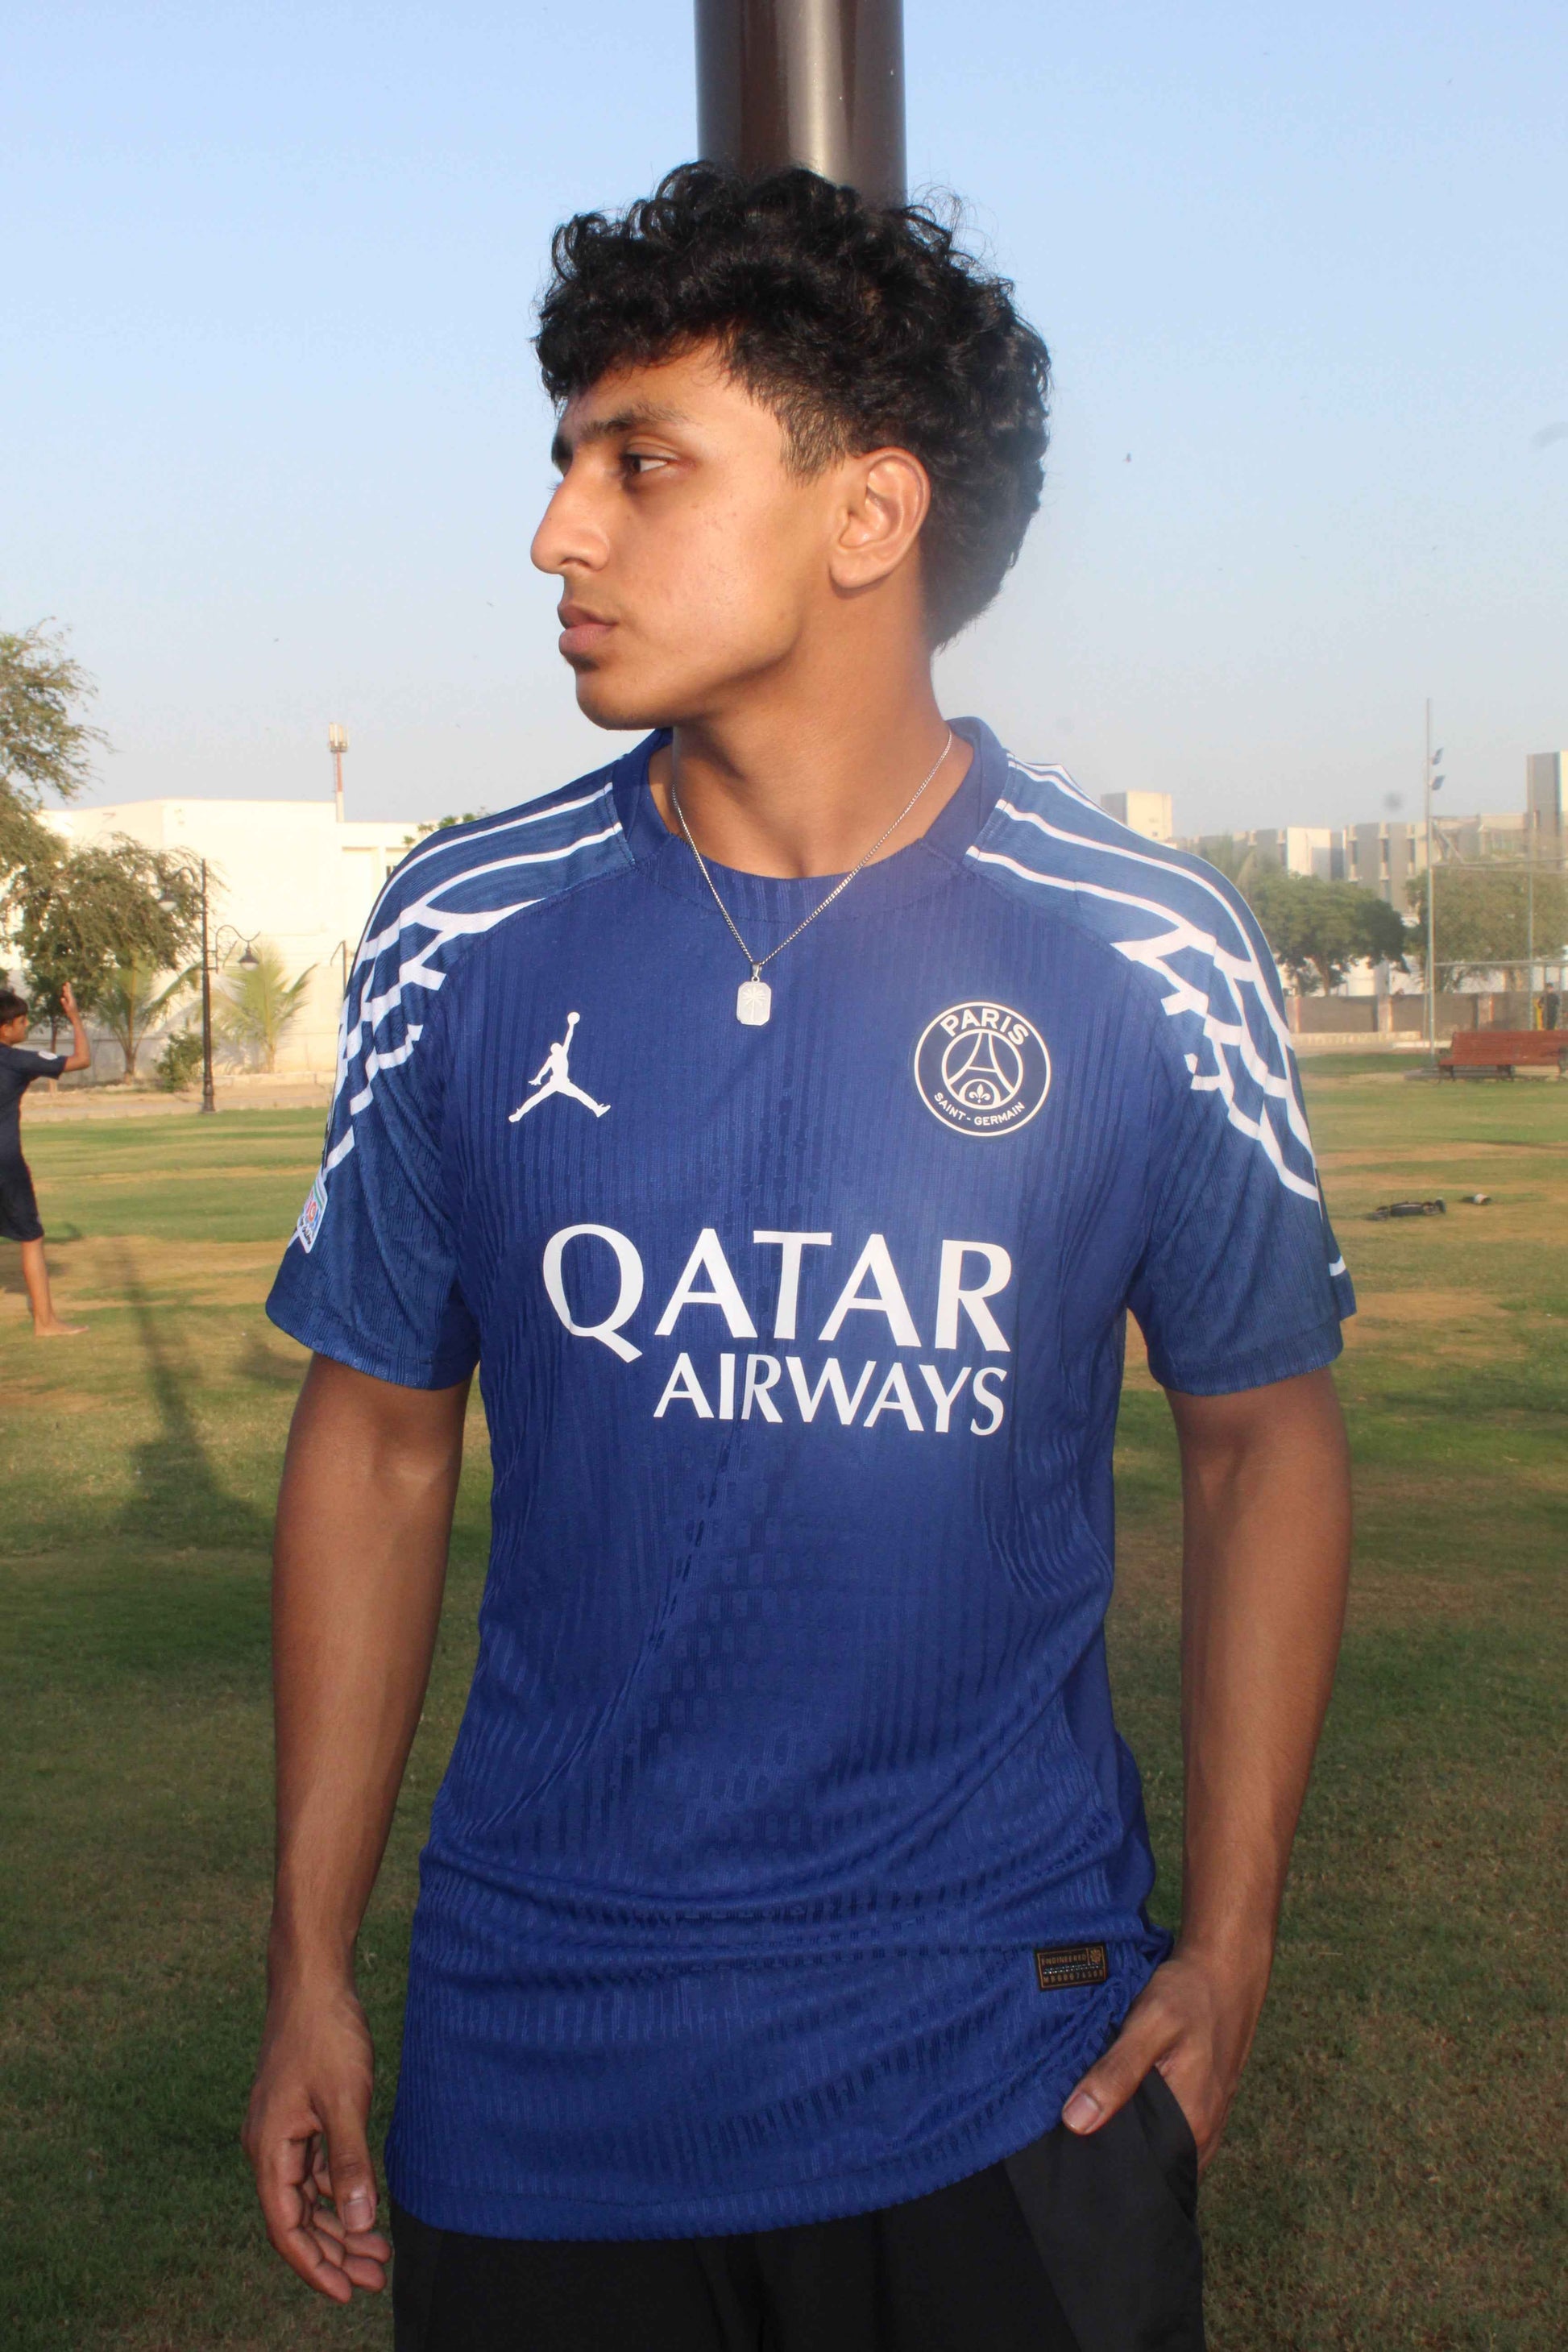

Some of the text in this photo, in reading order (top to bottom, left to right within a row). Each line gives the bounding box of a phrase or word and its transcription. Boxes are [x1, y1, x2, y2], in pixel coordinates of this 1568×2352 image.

[940, 1007, 1029, 1046] PARIS
[543, 1223, 1012, 1363] QATAR
[653, 1352, 1007, 1436] AIRWAYS
